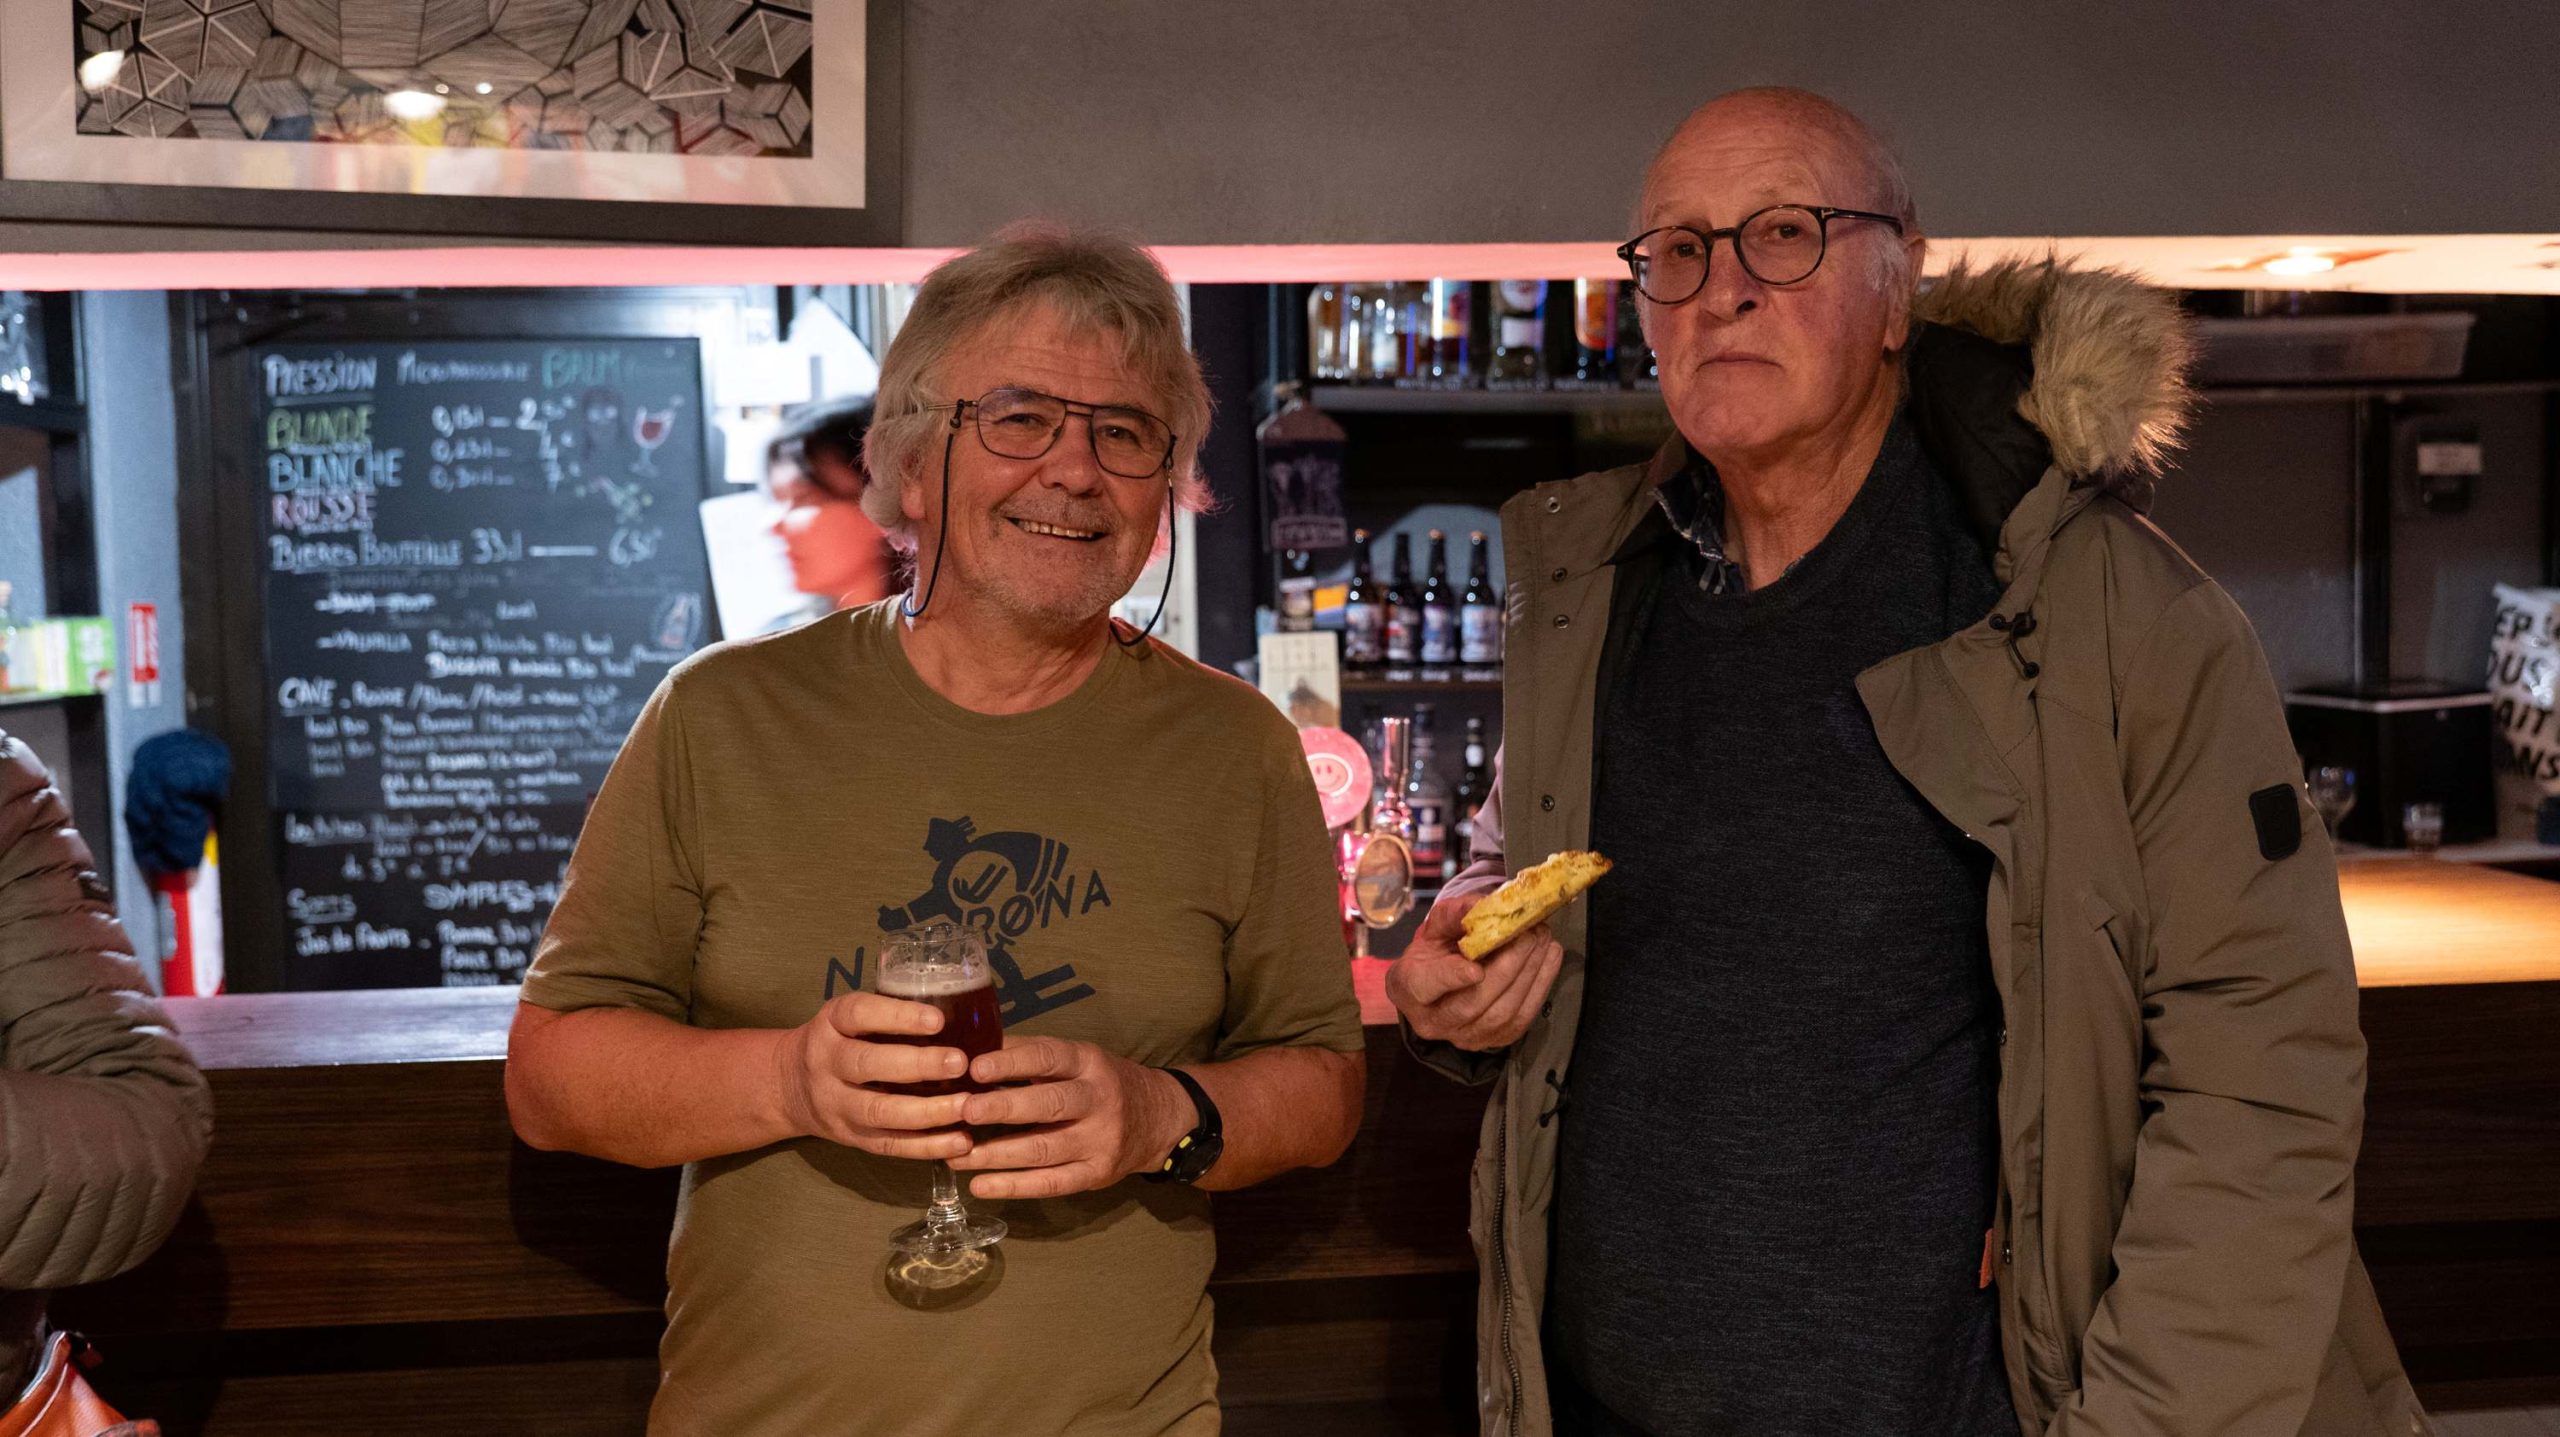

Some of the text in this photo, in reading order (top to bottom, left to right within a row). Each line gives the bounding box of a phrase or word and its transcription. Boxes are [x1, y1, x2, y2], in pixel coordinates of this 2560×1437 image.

[262, 350, 377, 397] PRESSION
[268, 448, 404, 492] BLANCHE
[271, 491, 375, 529] ROUSSE
